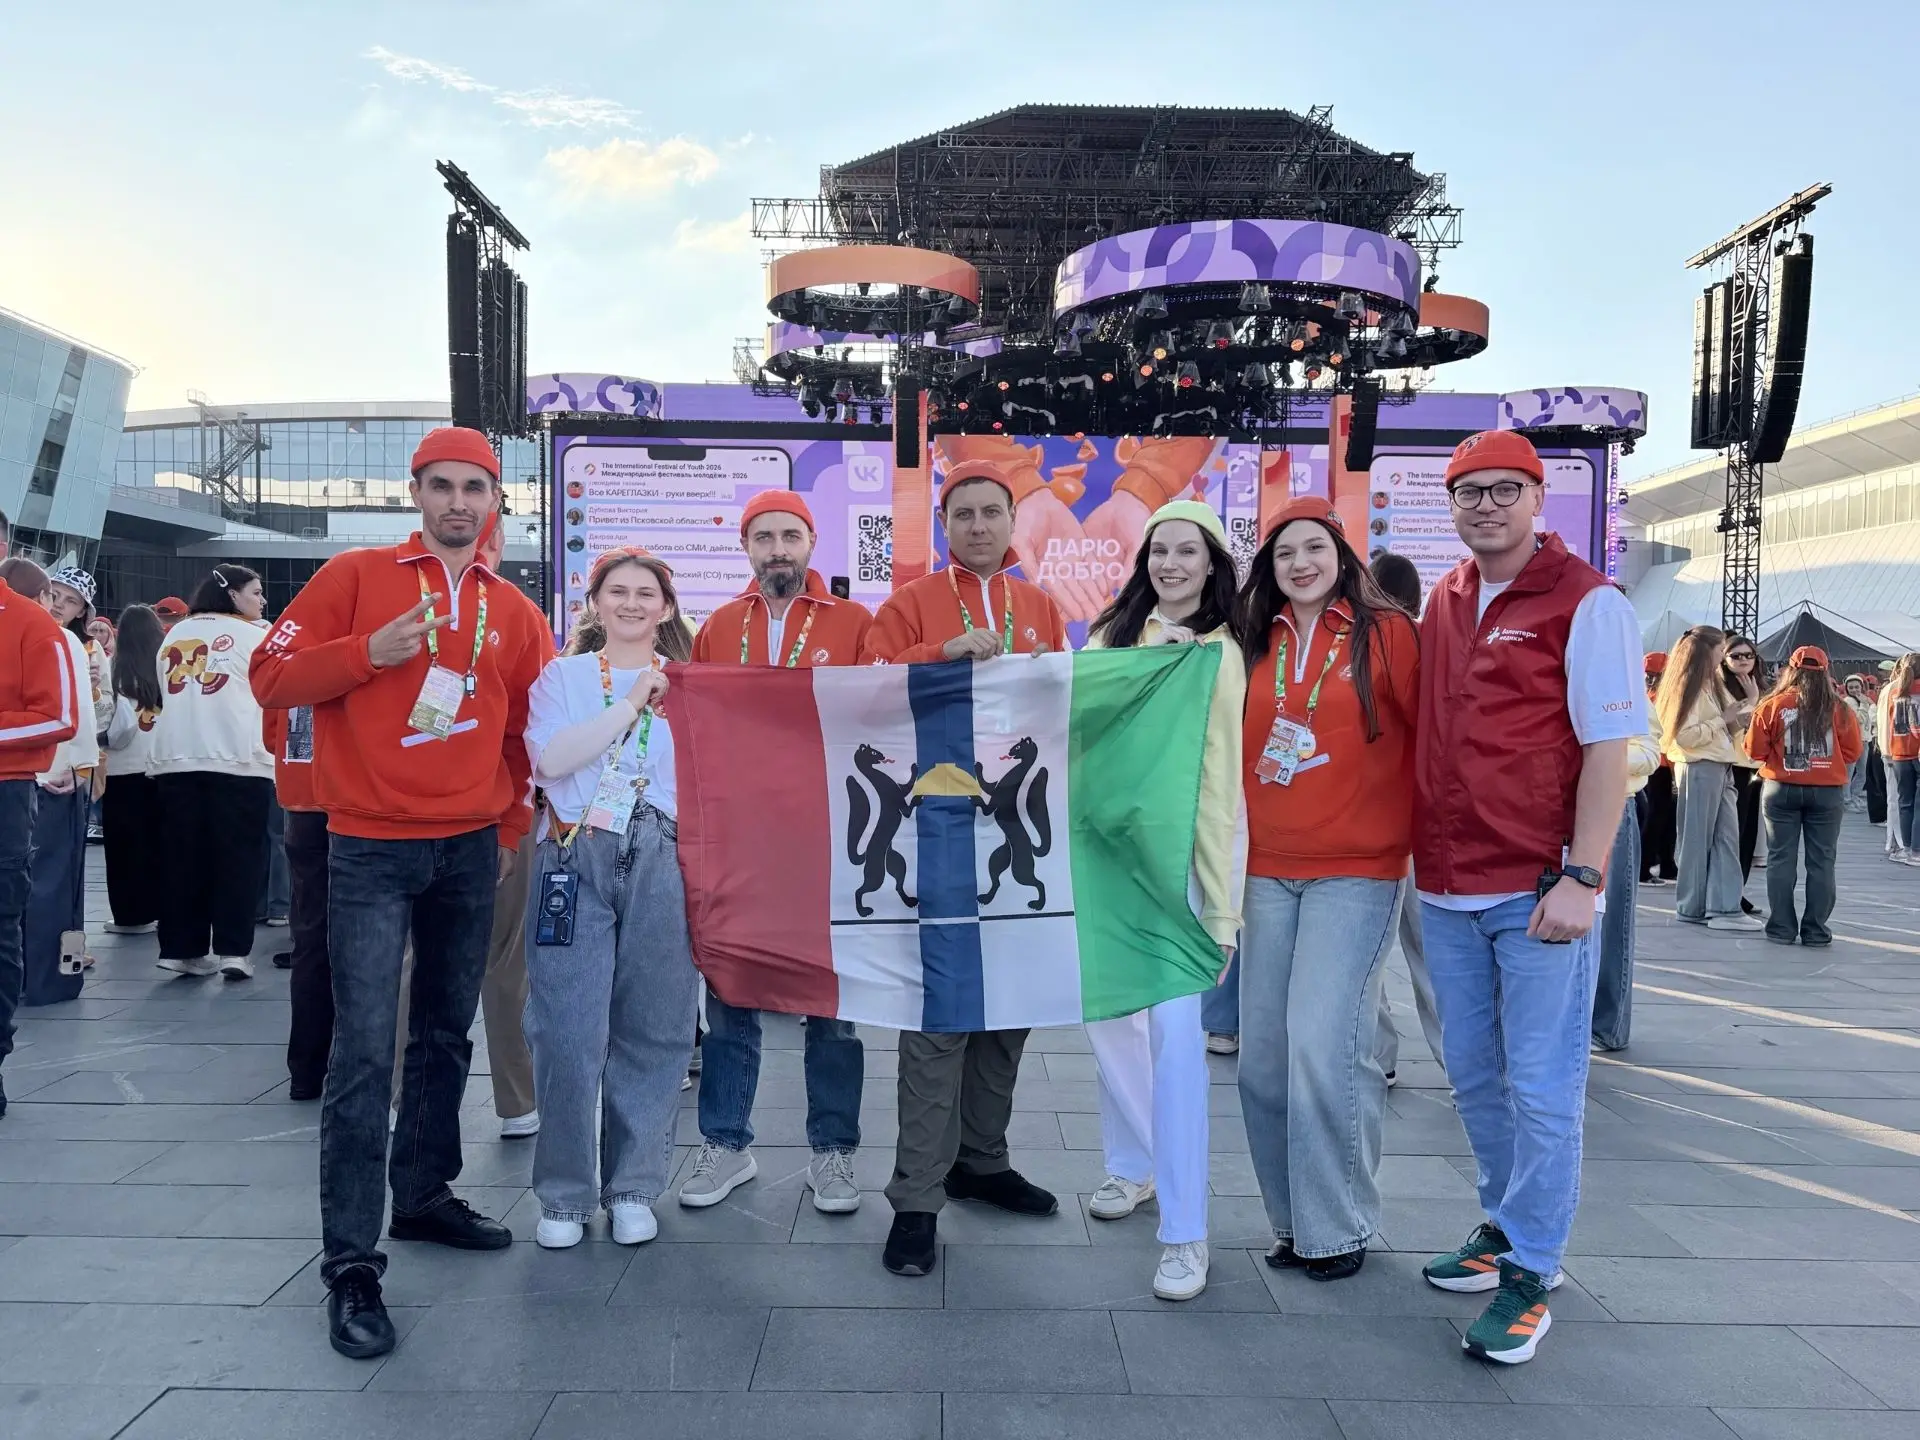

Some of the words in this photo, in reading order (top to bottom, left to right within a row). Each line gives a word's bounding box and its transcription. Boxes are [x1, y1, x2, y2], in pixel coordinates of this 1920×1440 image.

[601, 470, 656, 478] Международный
[658, 471, 692, 479] фестиваль
[854, 465, 879, 482] VK
[588, 488, 604, 496] Все
[605, 488, 659, 497] КАРЕГЛАЗКИ
[665, 491, 685, 499] руки
[1393, 499, 1409, 507] Все
[617, 507, 648, 515] Виктория
[589, 515, 619, 525] Привет
[630, 516, 674, 525] Псковской
[1392, 525, 1422, 535] Привет
[644, 544, 672, 552] работа
[685, 543, 708, 553] СМИ,
[1044, 537, 1121, 561] ДАРЮ
[703, 570, 722, 580] (СО)
[723, 572, 751, 580] привет
[1036, 561, 1124, 584] ДОБРО
